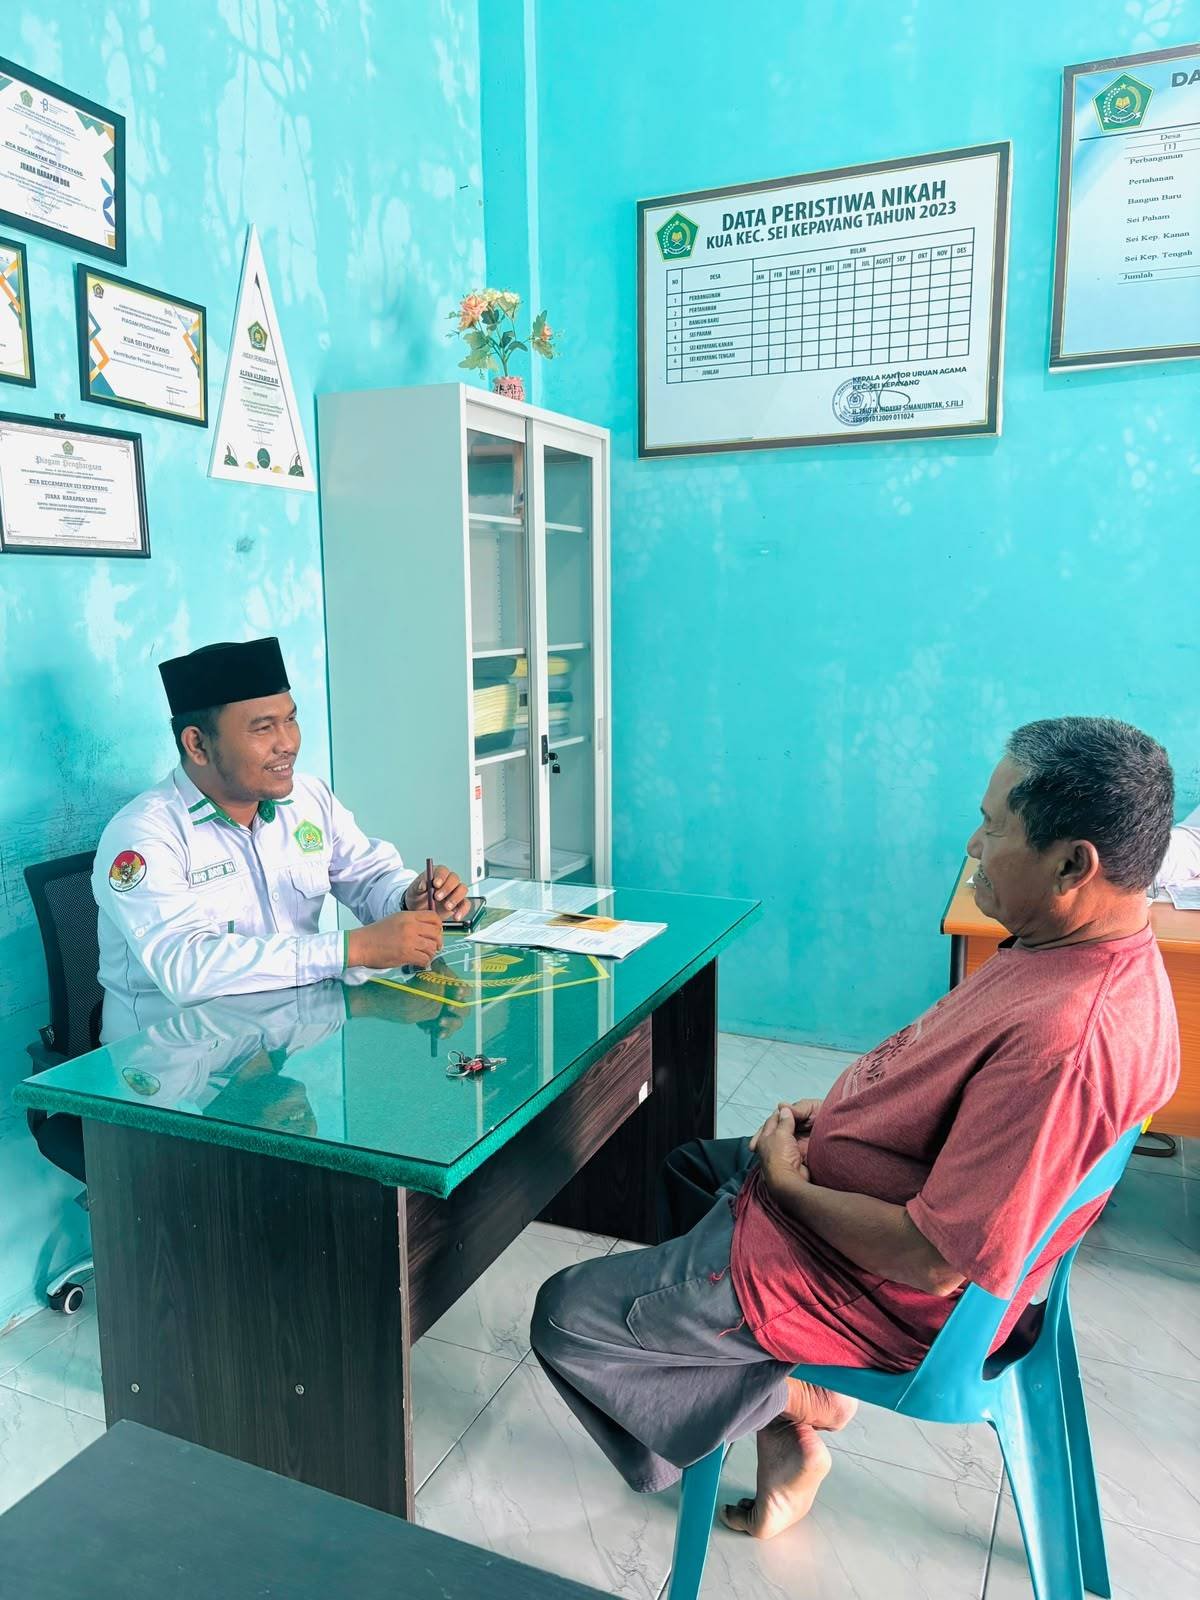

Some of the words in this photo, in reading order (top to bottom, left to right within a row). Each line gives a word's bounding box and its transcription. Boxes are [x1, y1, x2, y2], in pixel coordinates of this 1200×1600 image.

[1160, 133, 1181, 141] Desa
[1129, 153, 1183, 164] Perbangunan
[1128, 175, 1174, 185] Pertahanan
[1127, 196, 1159, 204] Bangun
[1161, 193, 1182, 201] Baru
[722, 207, 767, 231] DATA
[771, 191, 876, 224] PERISTIWA
[881, 180, 946, 208] NIKAH
[1142, 214, 1170, 222] Paham
[706, 233, 733, 249] KUA
[736, 229, 764, 245] KEC.
[767, 225, 788, 240] SEI
[791, 214, 863, 238] KEPAYANG
[866, 206, 915, 226] TAHUN
[919, 201, 956, 218] 2023
[1163, 231, 1190, 239] Kanan
[1162, 250, 1193, 259] Tengah
[1123, 271, 1153, 280] Jumlah
[688, 292, 721, 301] PERBANGUNAN
[688, 305, 717, 313] PERTAHANAN
[718, 352, 735, 360] TENGAH
[881, 371, 911, 380] KANTOR
[912, 368, 939, 377] URUAN
[939, 366, 967, 375] AGAMA
[881, 380, 920, 388] KEPAYANG
[894, 412, 915, 420] 011024
